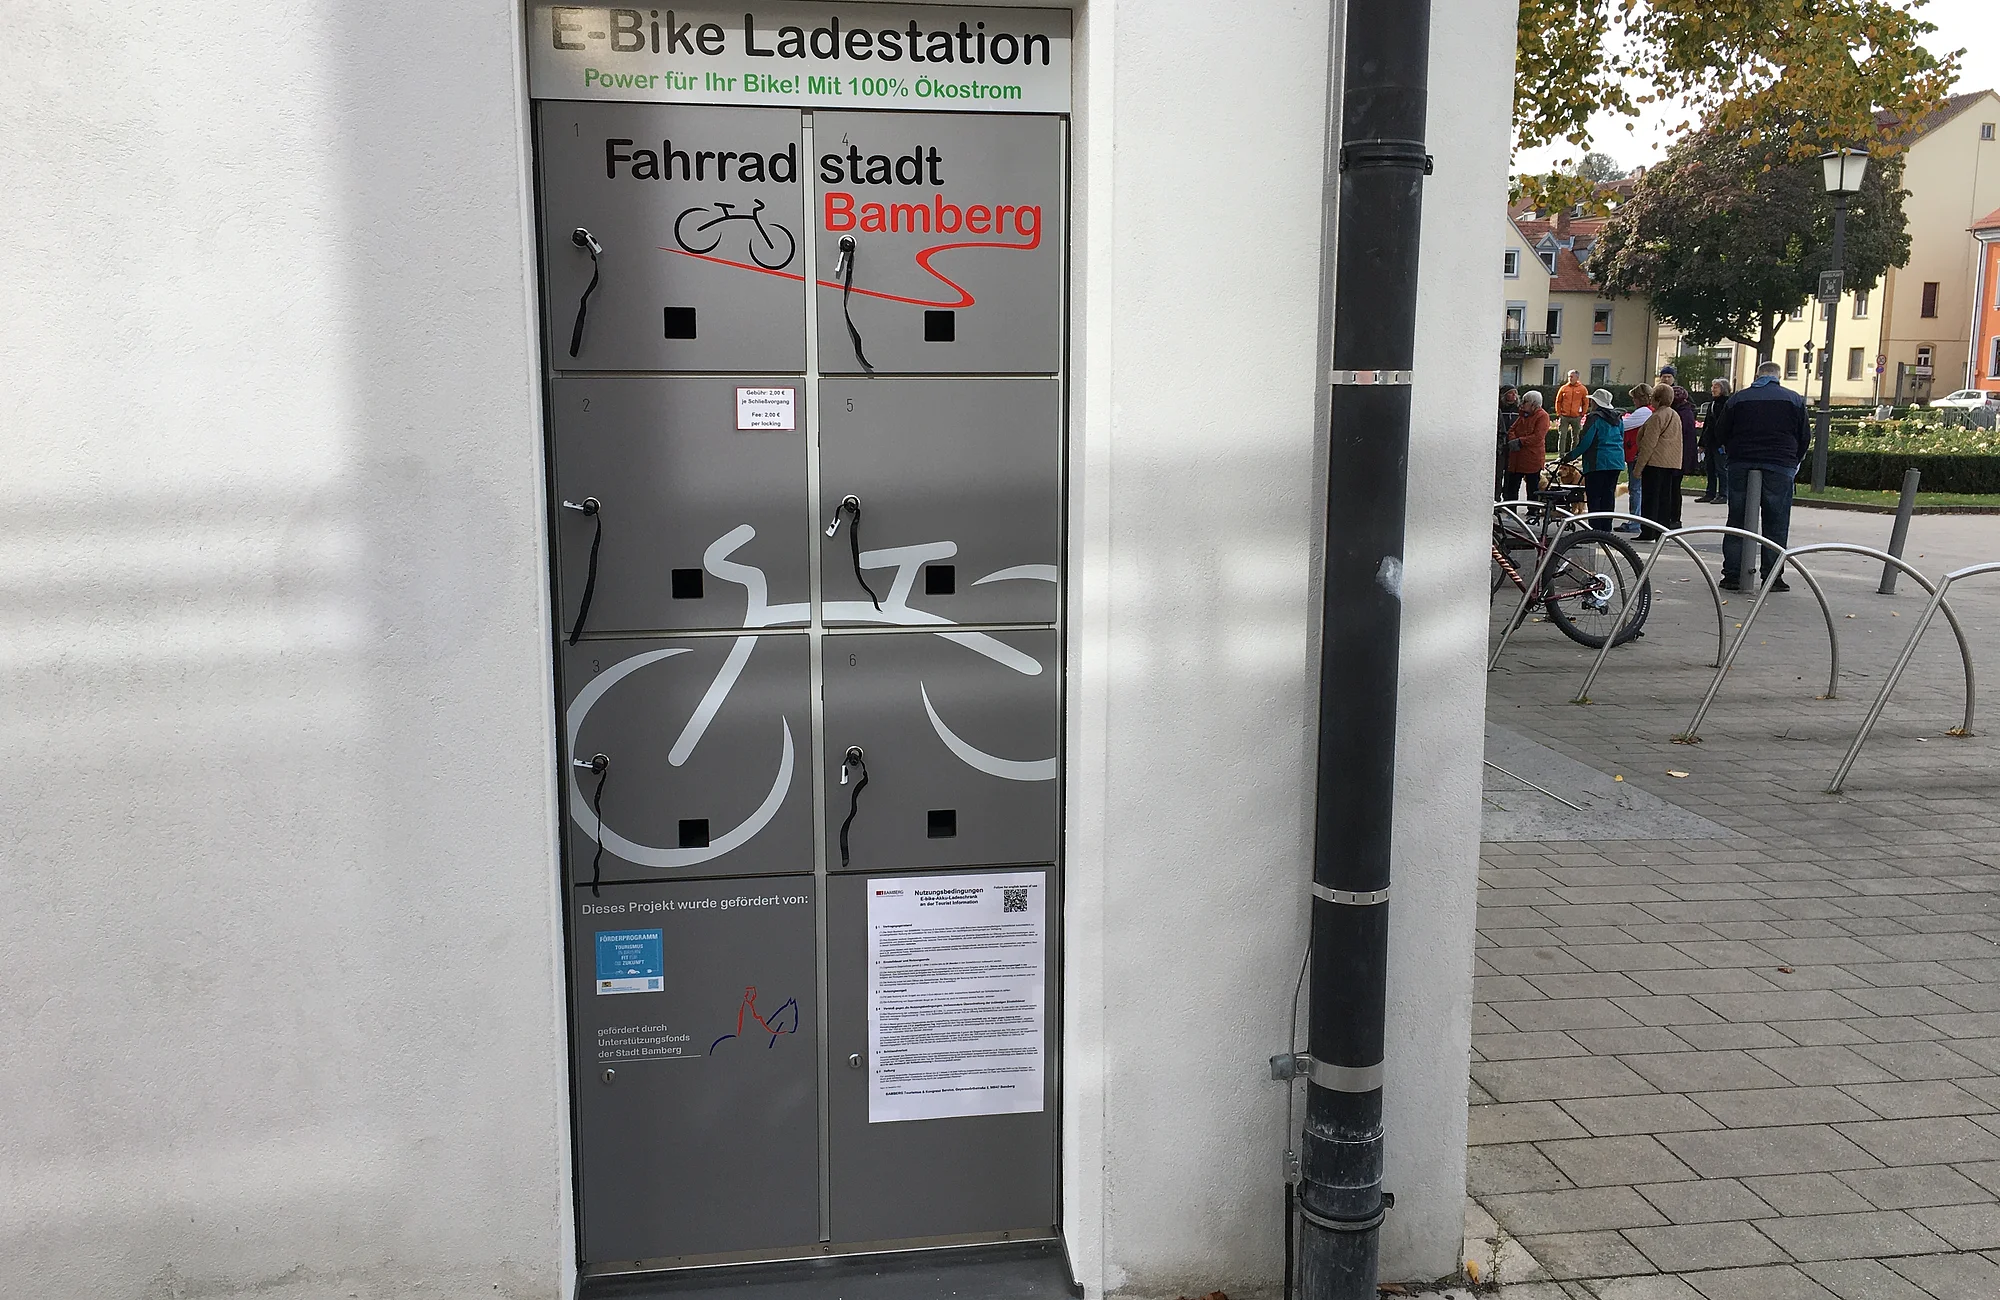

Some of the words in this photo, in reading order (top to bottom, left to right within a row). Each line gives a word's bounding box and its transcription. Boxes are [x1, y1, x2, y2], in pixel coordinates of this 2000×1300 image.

[552, 7, 725, 55] E-Bike
[744, 13, 1050, 65] Ladestation
[584, 68, 659, 89] Power
[665, 71, 698, 91] für
[705, 72, 737, 92] Ihr
[744, 73, 799, 94] Bike!
[808, 75, 842, 95] Mit
[849, 77, 909, 97] 100%
[915, 75, 1022, 99] Ökostrom
[573, 122, 580, 138] 1
[841, 131, 849, 147] 4
[605, 138, 797, 184] Fahrrad
[820, 144, 945, 186] stadt
[824, 192, 1041, 246] Bamberg
[582, 397, 591, 413] 2
[846, 398, 854, 413] 5
[592, 659, 600, 673] 3
[849, 653, 857, 667] 6
[914, 888, 984, 896] Nutzungsbedingungen
[582, 904, 625, 915] Dieses
[629, 900, 675, 914] Projekt
[678, 899, 717, 910] wurde
[720, 895, 780, 910] gefördert
[782, 895, 809, 905] von:
[599, 933, 659, 942] FÖRDERPROGRAMM
[597, 1026, 640, 1037] gefördert
[641, 1024, 667, 1033] durch
[598, 1034, 690, 1047] Unterstützungsfonds
[598, 1050, 614, 1058] der
[615, 1048, 640, 1057] Stadt
[641, 1046, 682, 1056] Bamberg
